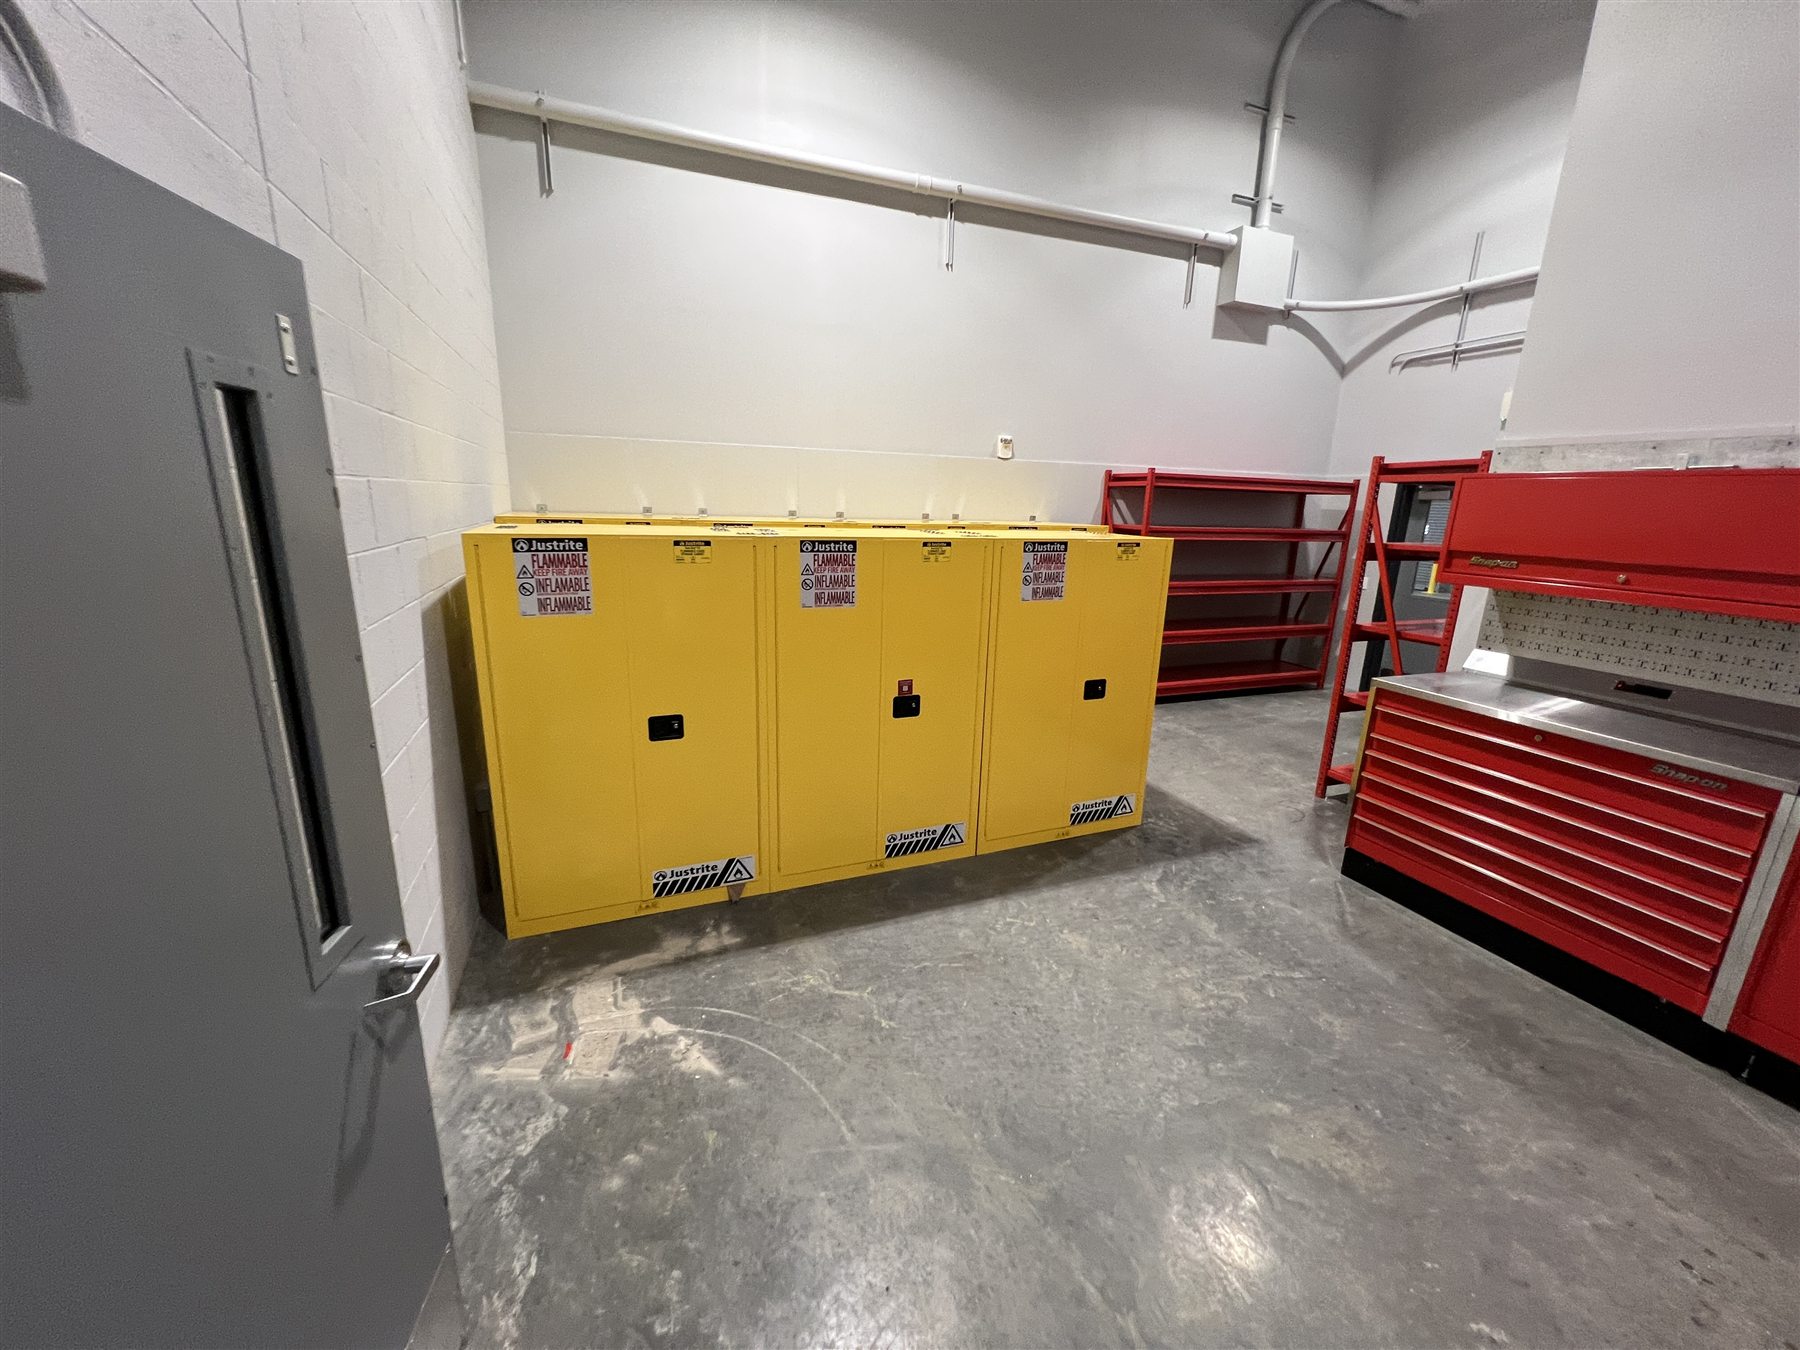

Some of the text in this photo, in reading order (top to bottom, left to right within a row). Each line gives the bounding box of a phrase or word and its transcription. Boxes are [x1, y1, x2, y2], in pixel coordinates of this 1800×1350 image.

[530, 540, 584, 551] Justrite
[813, 542, 854, 551] Justrite
[1034, 543, 1066, 552] Justrite
[531, 553, 588, 568] FLAMMABLE
[813, 554, 856, 567] FLAMMABLE
[1033, 553, 1066, 565] FLAMMABLE
[535, 577, 590, 593] INFLAMABLE
[815, 575, 855, 588] INFLAMABLE
[537, 596, 592, 613] INFLAMMABLE
[814, 591, 855, 605] INFLAMMABLE
[1651, 764, 1728, 789] Snap-on
[1081, 800, 1113, 811] Justrite
[899, 829, 937, 841] Justrite
[669, 864, 718, 879] Justrite
